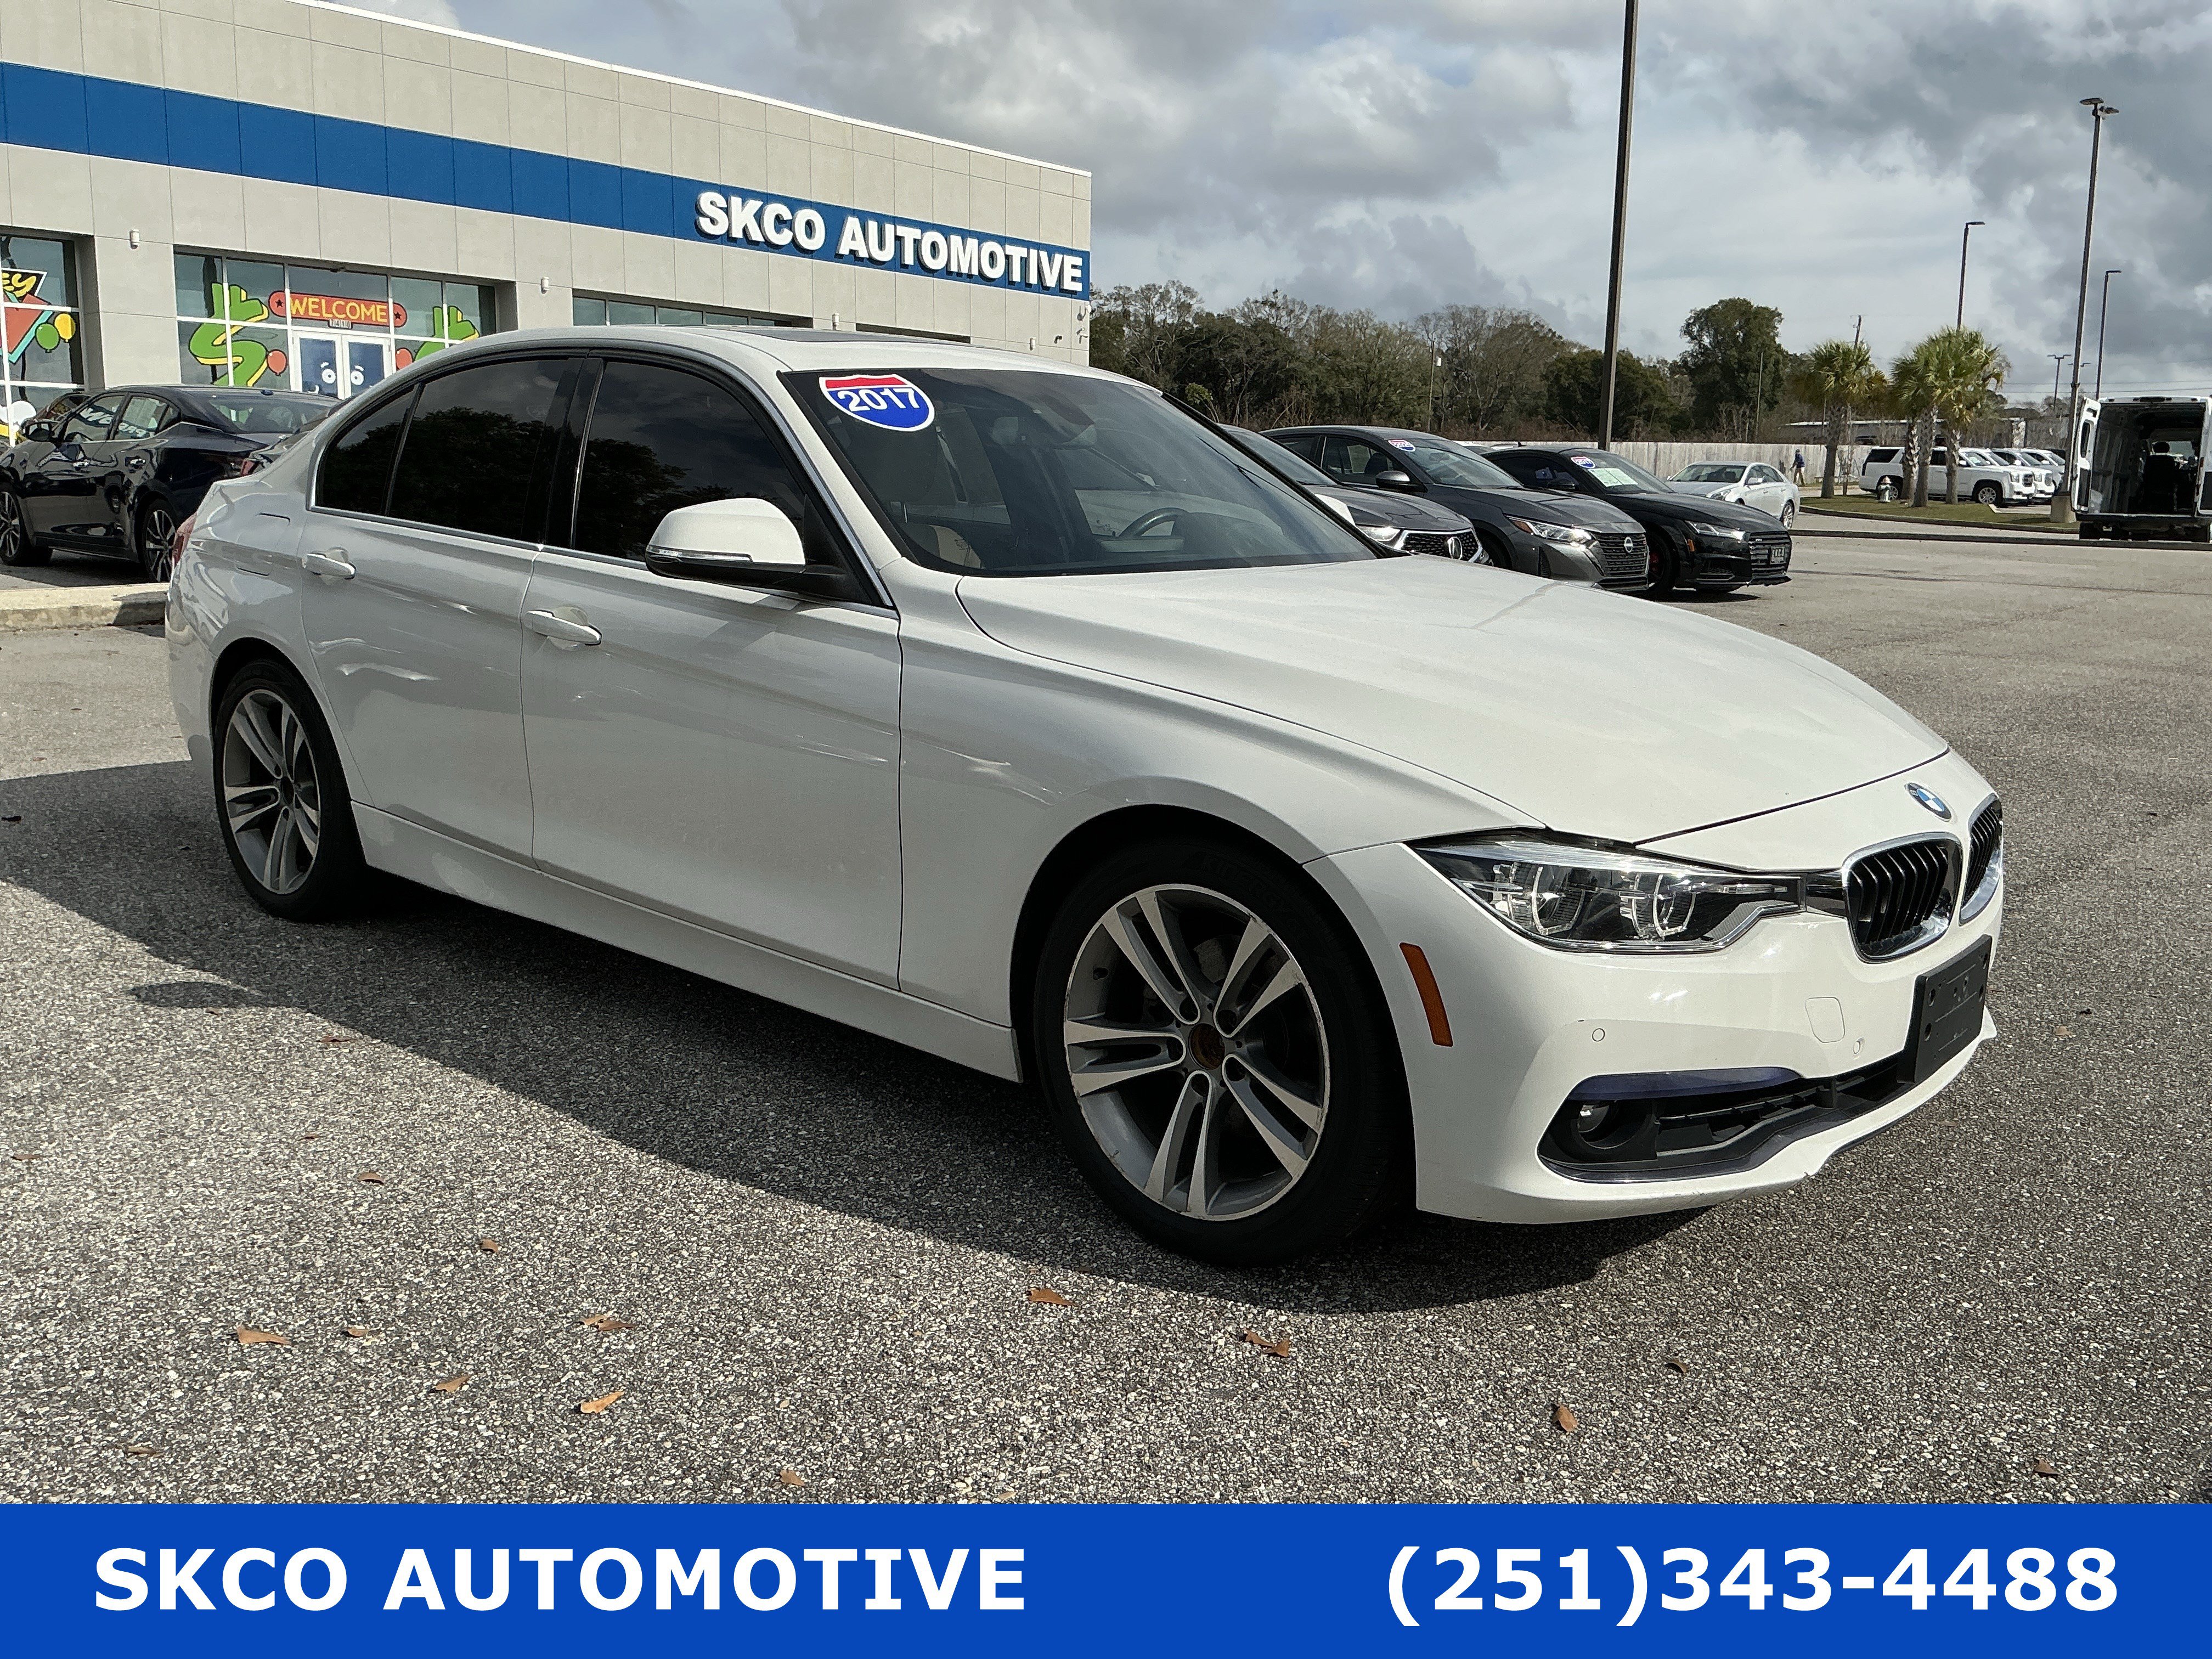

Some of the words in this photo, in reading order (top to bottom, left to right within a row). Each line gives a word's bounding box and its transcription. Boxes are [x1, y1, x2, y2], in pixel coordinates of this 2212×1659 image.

[696, 191, 825, 250] SKCO
[836, 216, 1082, 292] AUTOMOTIVE
[290, 297, 388, 323] WELCOME
[837, 388, 921, 412] 2017
